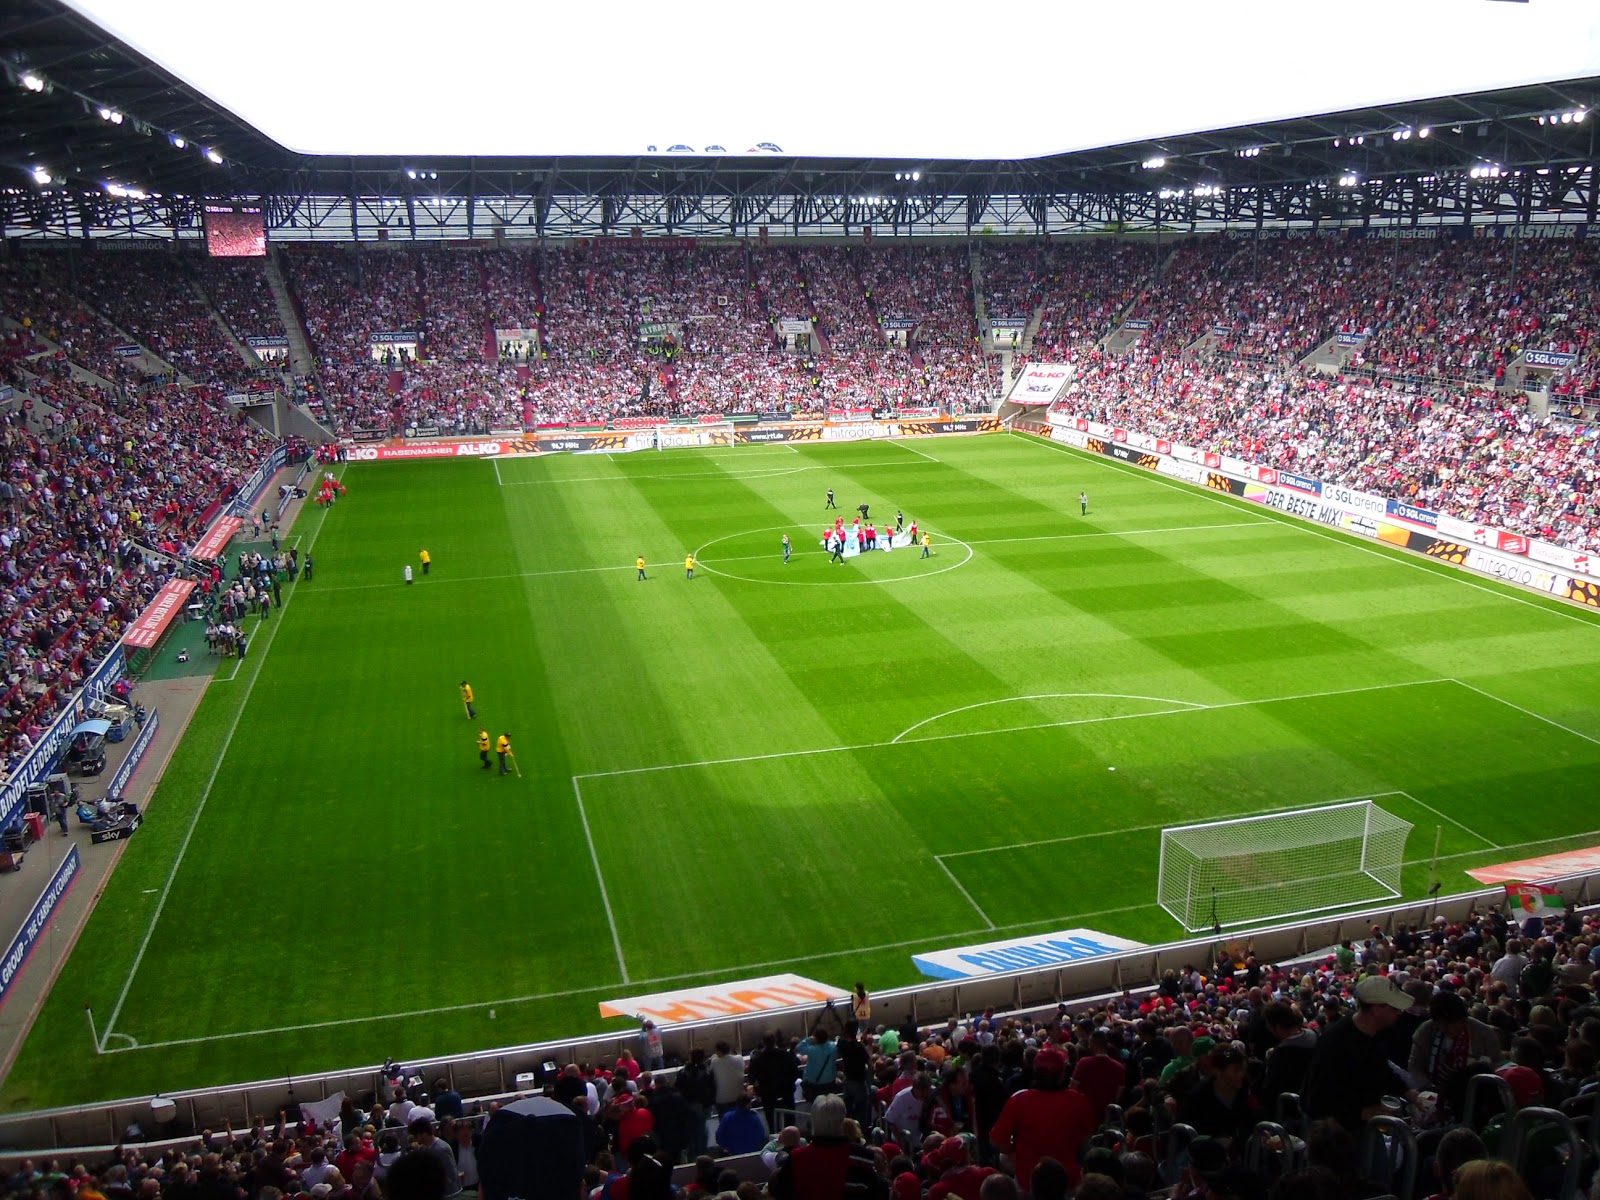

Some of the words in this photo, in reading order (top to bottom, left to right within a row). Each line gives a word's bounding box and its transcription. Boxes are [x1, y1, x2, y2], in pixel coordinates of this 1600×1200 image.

[1377, 228, 1436, 239] Abenstein
[1503, 225, 1577, 238] KASTNER
[96, 241, 164, 250] Familienblock
[1534, 354, 1549, 364] SGL
[830, 426, 874, 438] hitradio
[457, 443, 501, 456] AL-KO
[1286, 477, 1296, 485] SGL
[1296, 480, 1311, 490] arena
[1335, 489, 1352, 504] SGL
[1354, 495, 1384, 513] arena
[1266, 490, 1285, 509] DER
[1287, 496, 1317, 518] BESTE
[1318, 505, 1344, 527] MIX!
[1406, 510, 1419, 519] SGL
[1419, 513, 1438, 525] arena
[1476, 556, 1532, 584] hitradio
[29, 710, 76, 779] LEIDENSCHAFT
[102, 831, 120, 841] sky
[2, 942, 24, 984] GROUP
[27, 920, 38, 942] THE
[37, 888, 57, 927] CARBON
[55, 855, 77, 896] COMPANY
